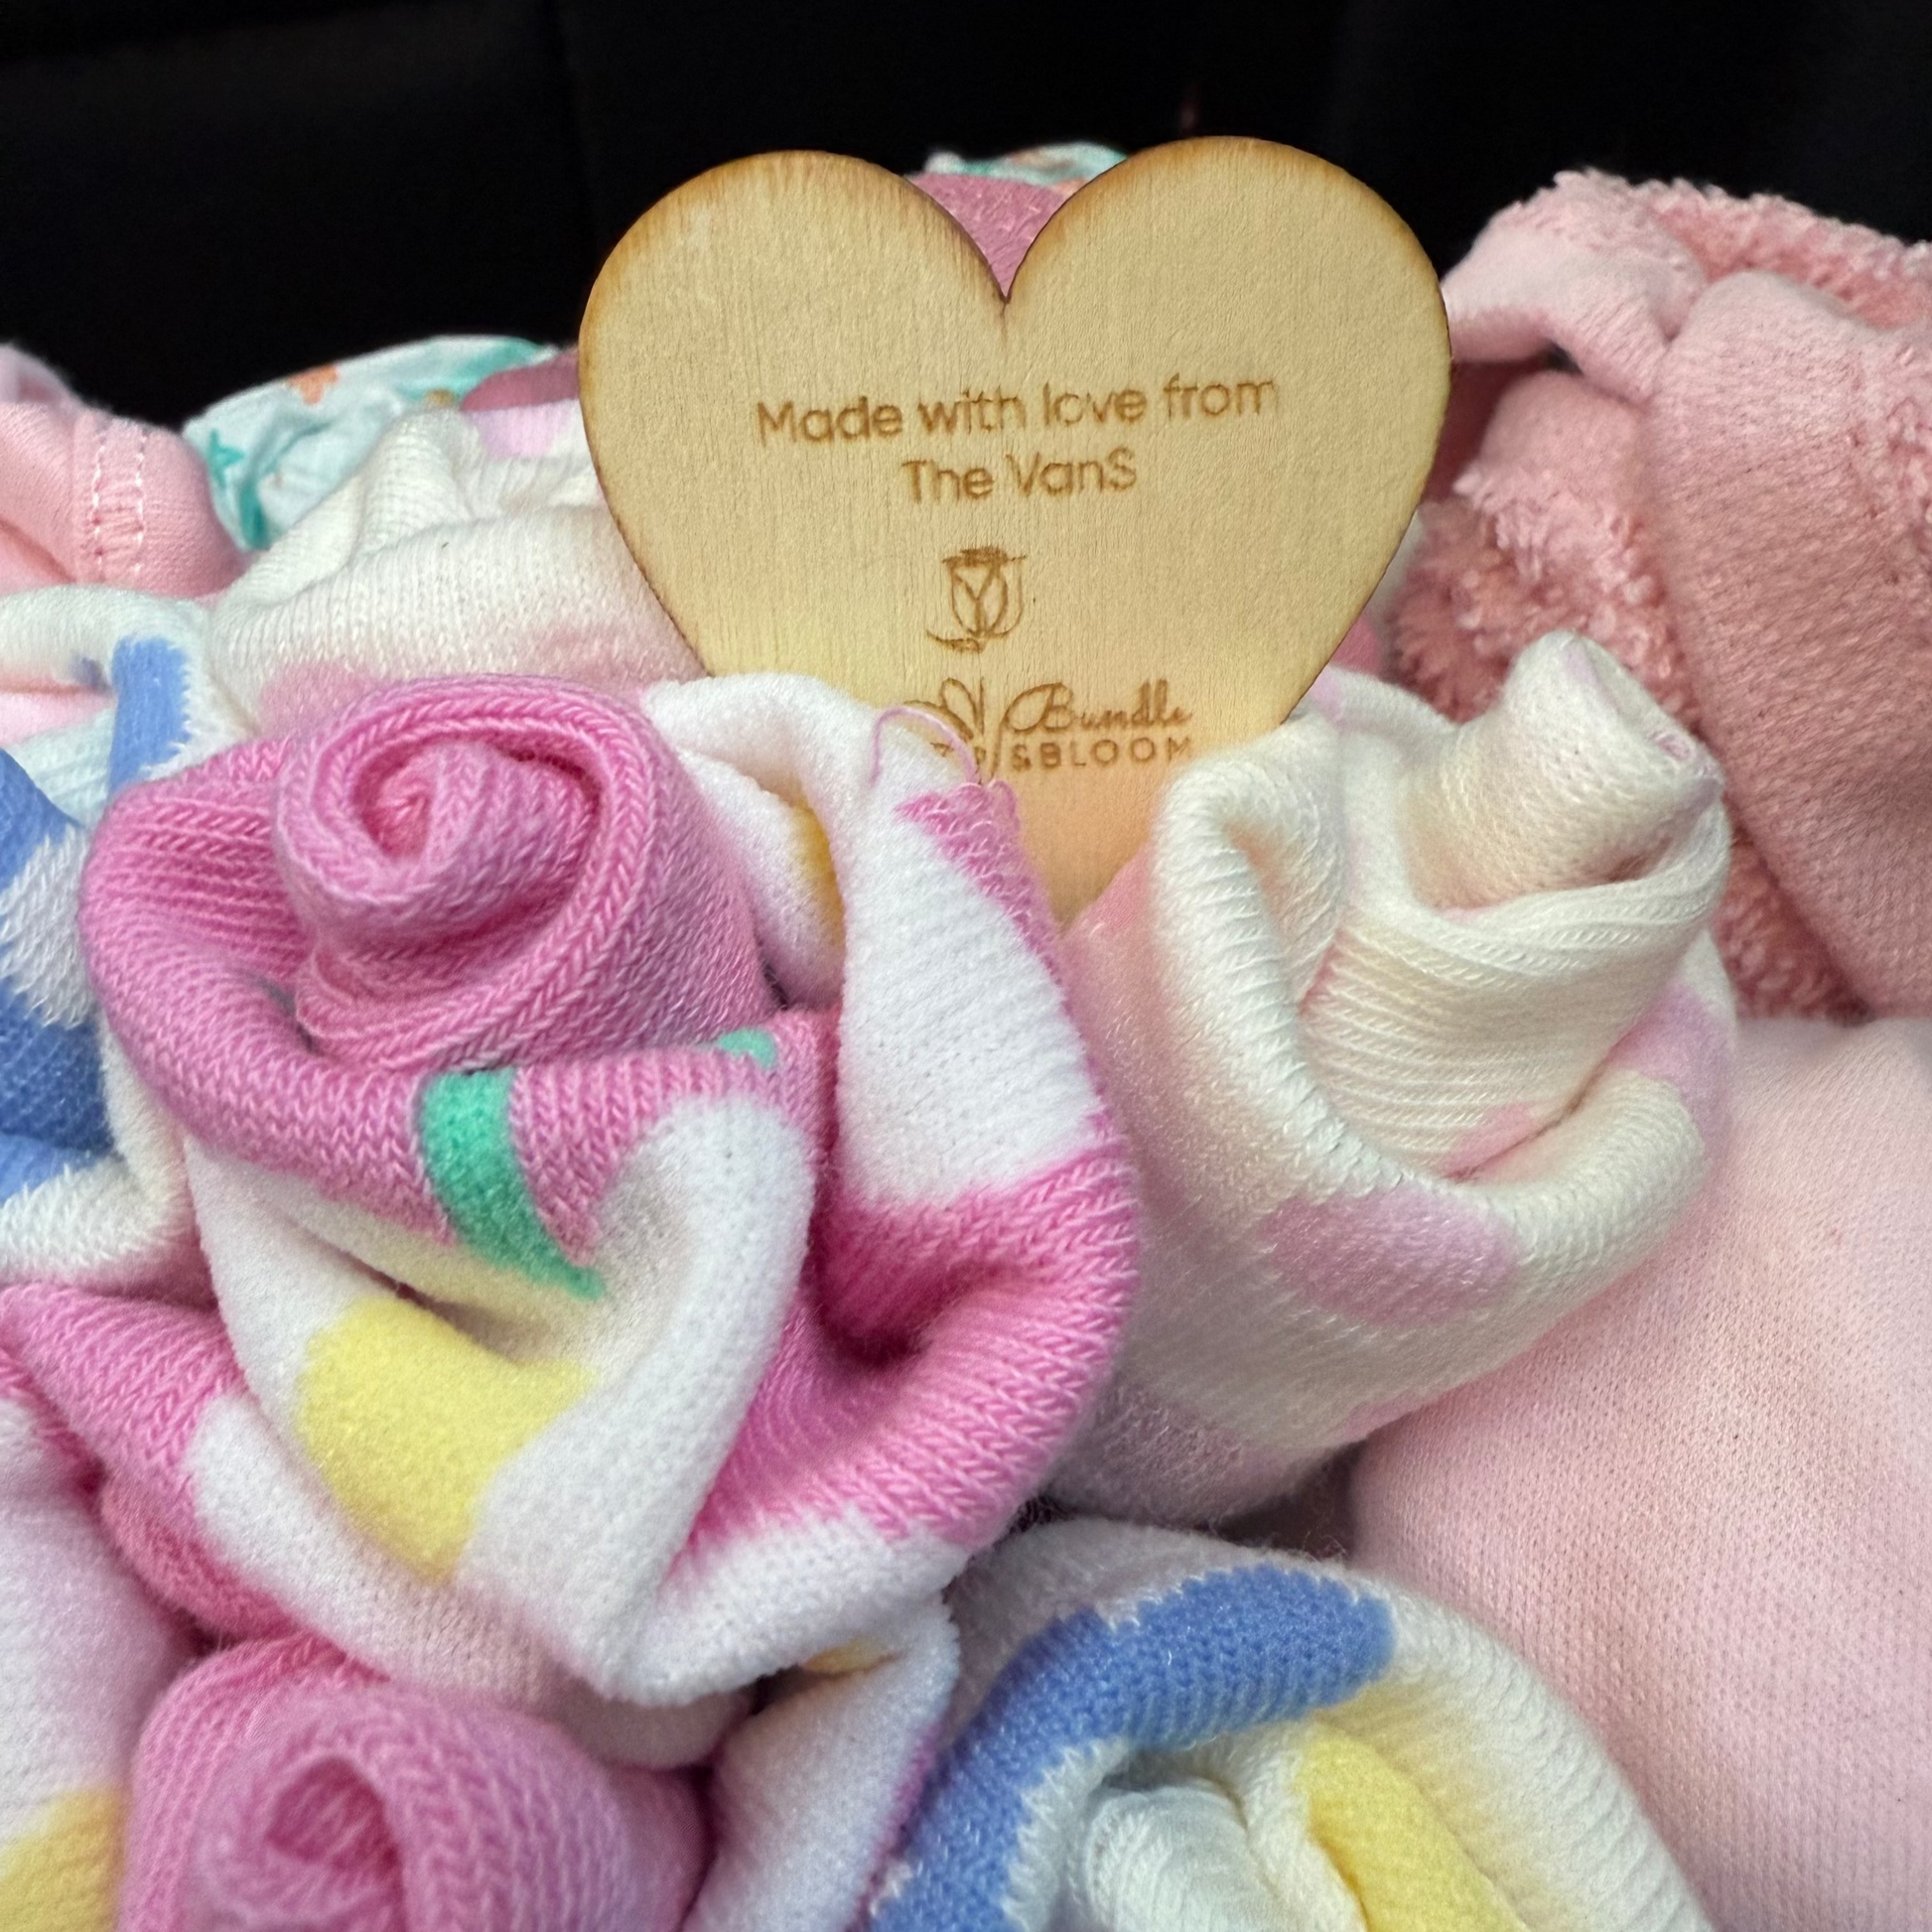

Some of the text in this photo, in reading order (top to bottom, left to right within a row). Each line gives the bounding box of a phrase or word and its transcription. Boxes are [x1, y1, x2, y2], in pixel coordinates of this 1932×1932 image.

[758, 372, 1279, 447] Made with love from
[901, 448, 1137, 504] The VanS
[1002, 678, 1192, 734] Bundle
